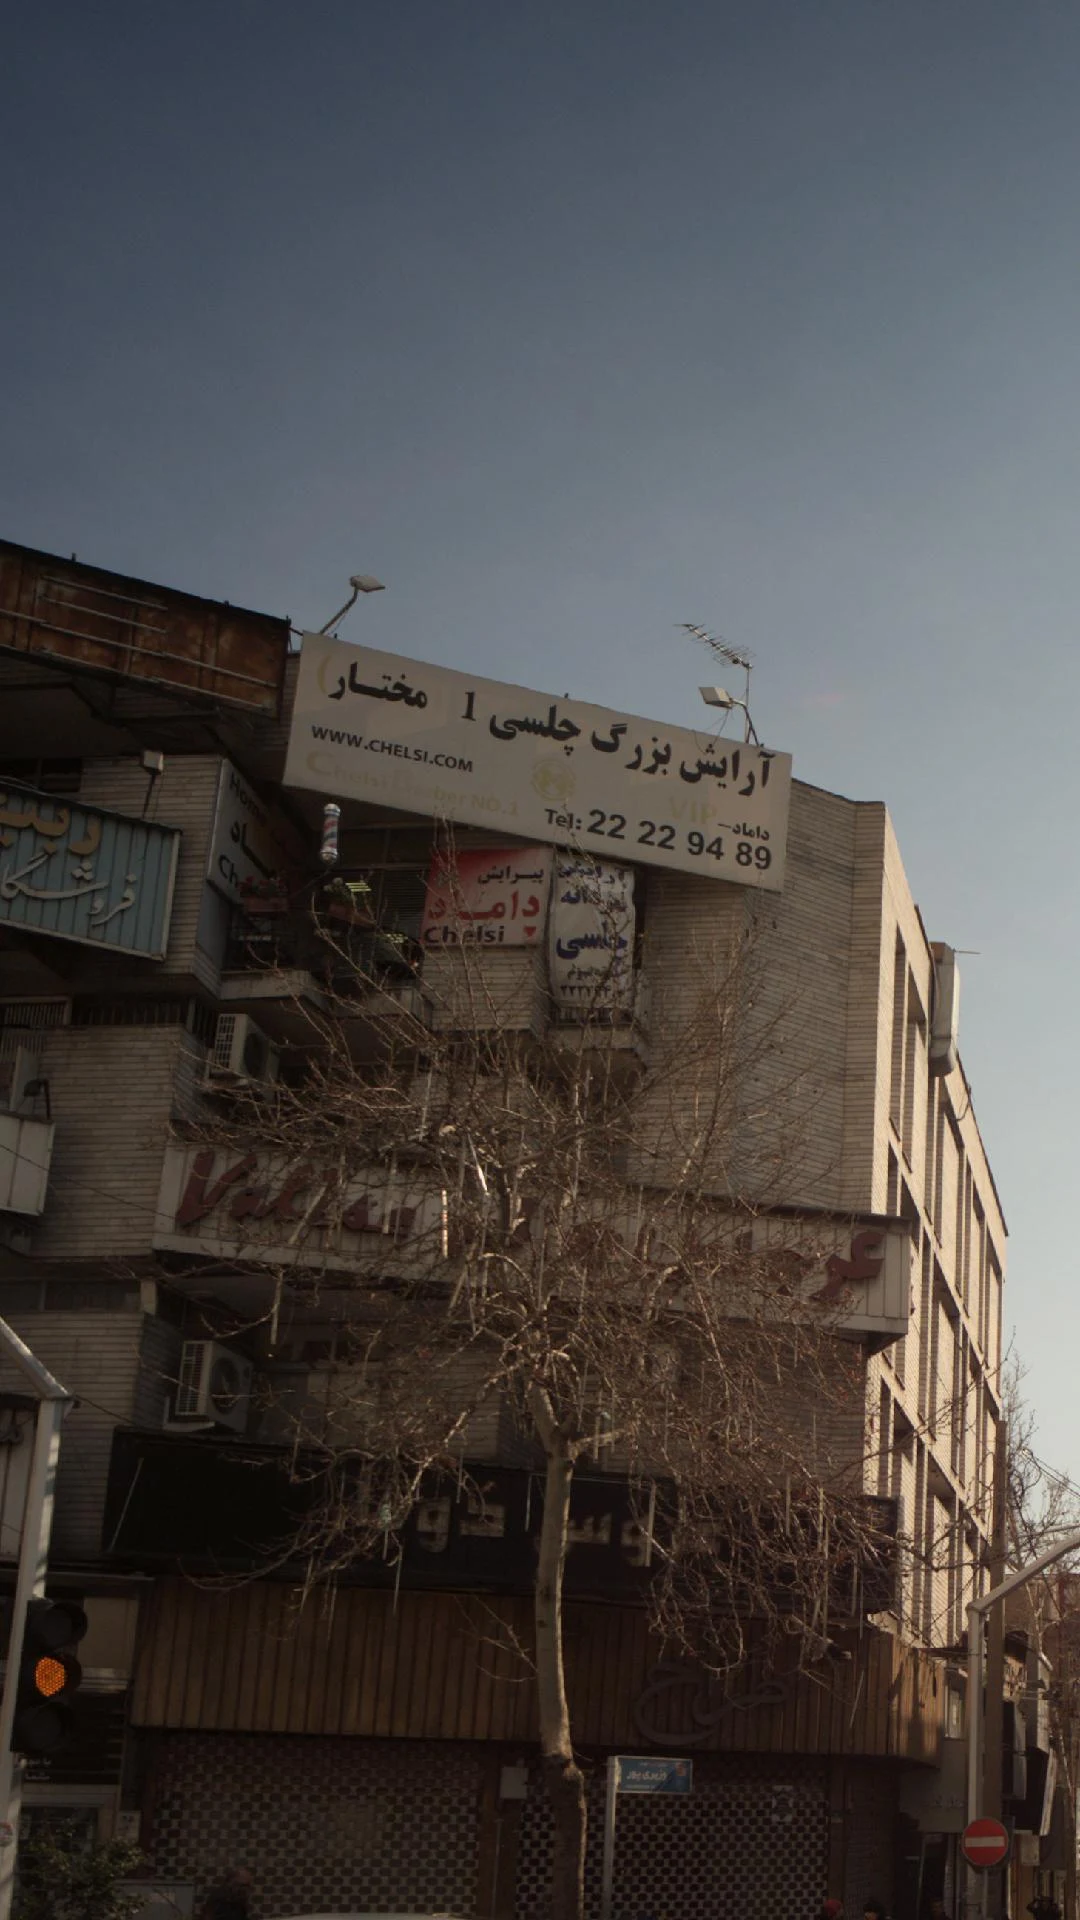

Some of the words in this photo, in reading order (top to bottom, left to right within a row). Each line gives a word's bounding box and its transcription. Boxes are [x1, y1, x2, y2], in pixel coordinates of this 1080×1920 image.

[311, 724, 474, 773] WWW.CHELSI.COM
[489, 705, 581, 756] چلسی
[591, 722, 672, 775] بزرگ
[680, 743, 776, 796] آرایش
[545, 808, 582, 830] Tel:
[587, 809, 627, 840] 22
[638, 820, 676, 850] 22
[687, 831, 725, 861] 94
[735, 842, 772, 870] 89
[428, 889, 540, 920] دامد
[423, 925, 505, 944] Chelsi
